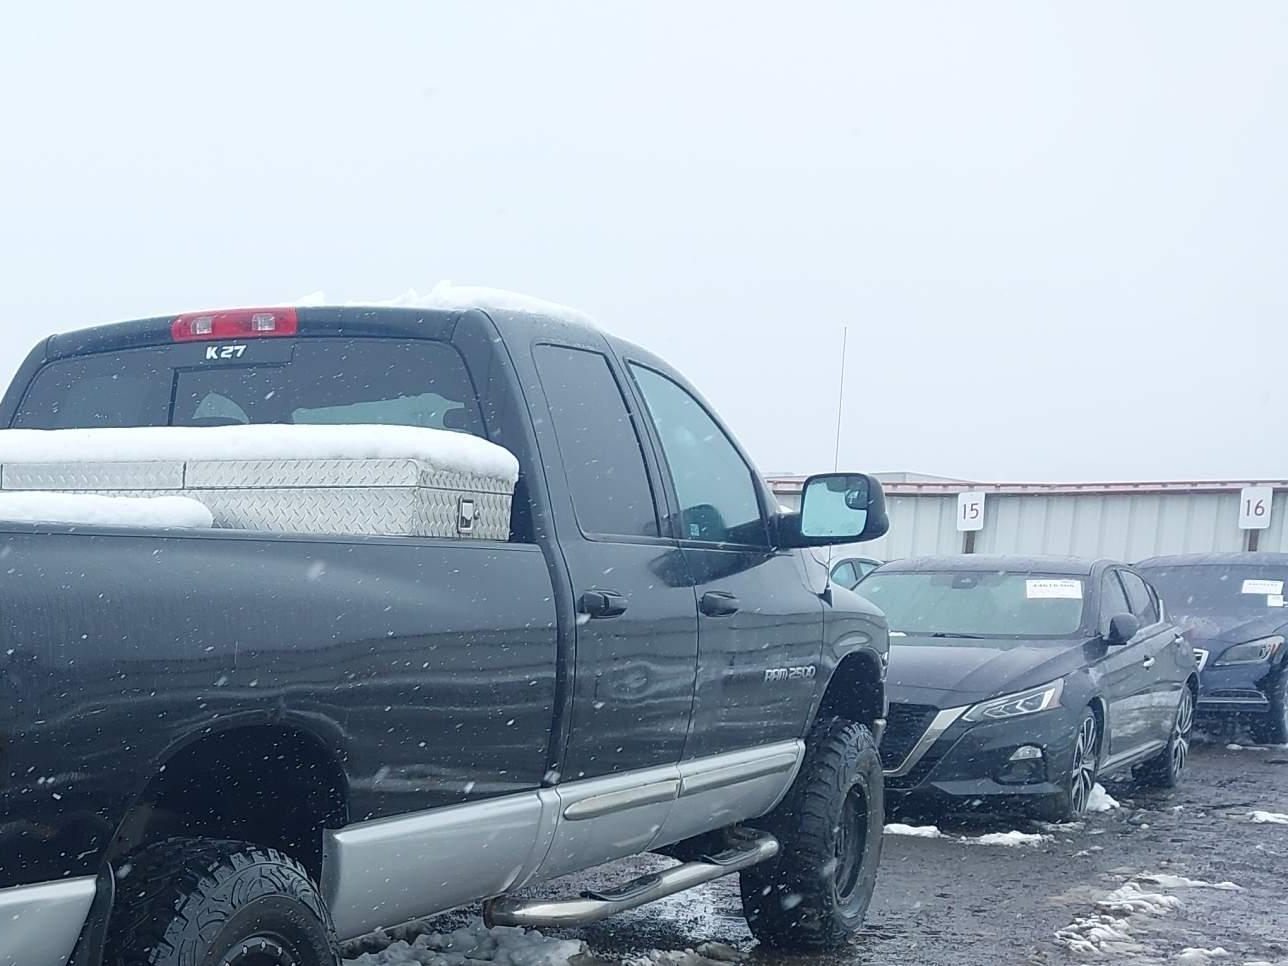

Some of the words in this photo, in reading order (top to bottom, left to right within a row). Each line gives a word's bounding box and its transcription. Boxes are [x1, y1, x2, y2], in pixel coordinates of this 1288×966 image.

[963, 502, 979, 520] 15
[1246, 499, 1265, 517] 16
[765, 668, 788, 681] RAM
[789, 665, 816, 679] 2500
